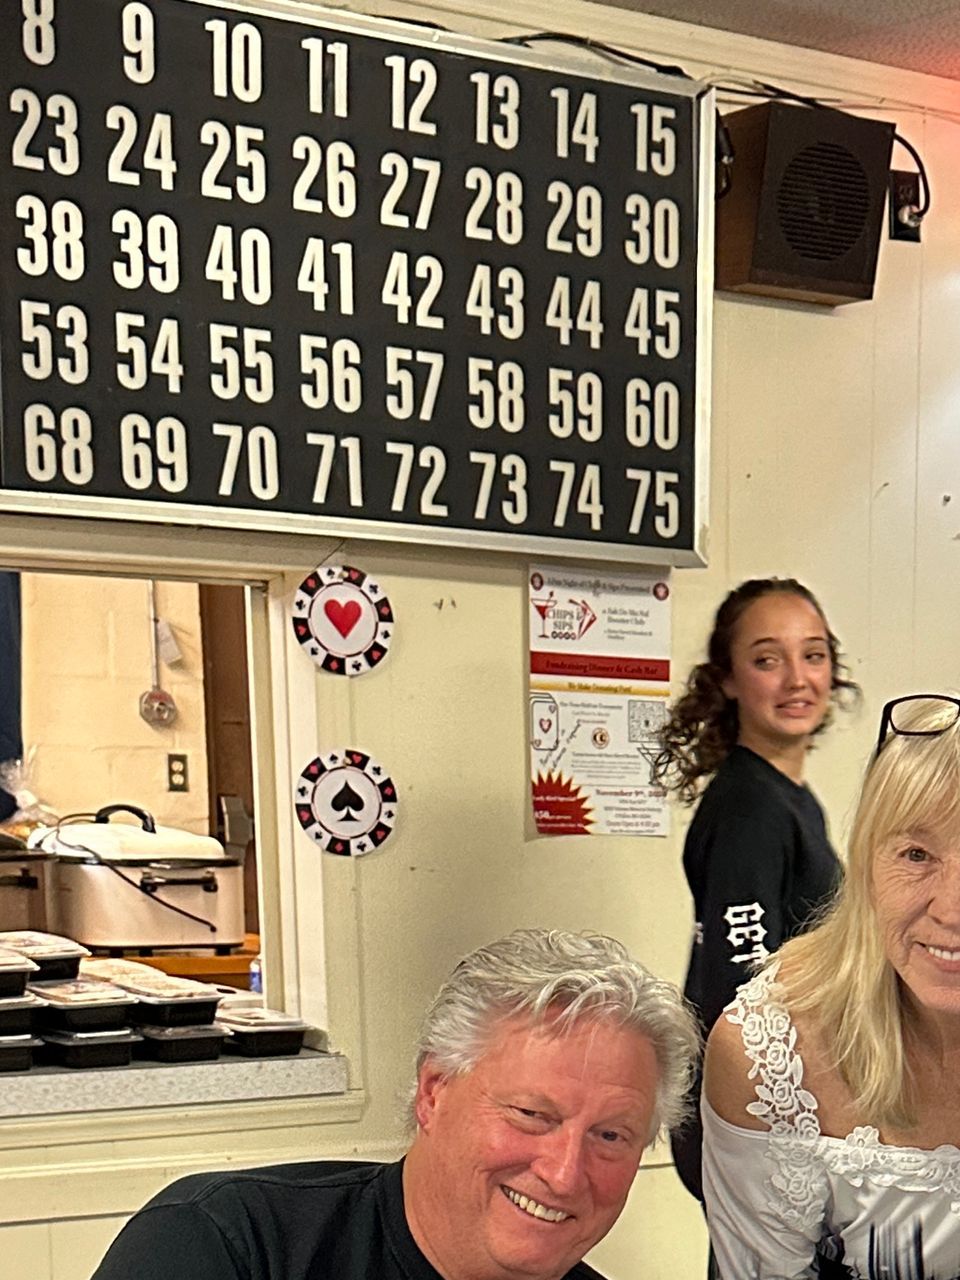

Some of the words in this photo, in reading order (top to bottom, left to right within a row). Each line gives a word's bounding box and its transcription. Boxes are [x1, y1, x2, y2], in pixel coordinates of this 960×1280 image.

[22, 0, 54, 65] 8
[123, 2, 154, 83] 9
[205, 20, 261, 102] 10
[302, 38, 347, 117] 11
[385, 56, 436, 135] 12
[471, 72, 519, 149] 13
[551, 88, 598, 162] 14
[631, 104, 675, 176] 15
[10, 89, 79, 175] 23
[106, 106, 176, 190] 24
[201, 121, 265, 203] 25
[293, 136, 356, 217] 26
[381, 153, 440, 229] 27
[466, 168, 522, 244] 28
[547, 182, 601, 257] 29
[626, 194, 678, 268] 30
[16, 195, 84, 280] 38
[112, 210, 179, 293] 39
[206, 225, 271, 305] 40
[298, 238, 353, 315] 41
[382, 252, 443, 329] 42
[466, 265, 523, 339] 43
[546, 277, 603, 349] 44
[625, 288, 679, 358] 45
[21, 300, 88, 384] 53
[116, 312, 183, 393] 54
[210, 324, 273, 403] 55
[300, 335, 361, 412] 56
[387, 347, 443, 420] 57
[469, 358, 524, 432] 58
[549, 368, 601, 441] 59
[626, 379, 678, 449] 60
[25, 404, 93, 484] 68
[121, 414, 188, 492] 69
[213, 424, 278, 500] 70
[307, 433, 362, 506] 71
[386, 442, 447, 516] 72
[470, 452, 527, 524] 73
[550, 461, 603, 530] 74
[627, 469, 678, 537] 75
[724, 902, 770, 963] GET
